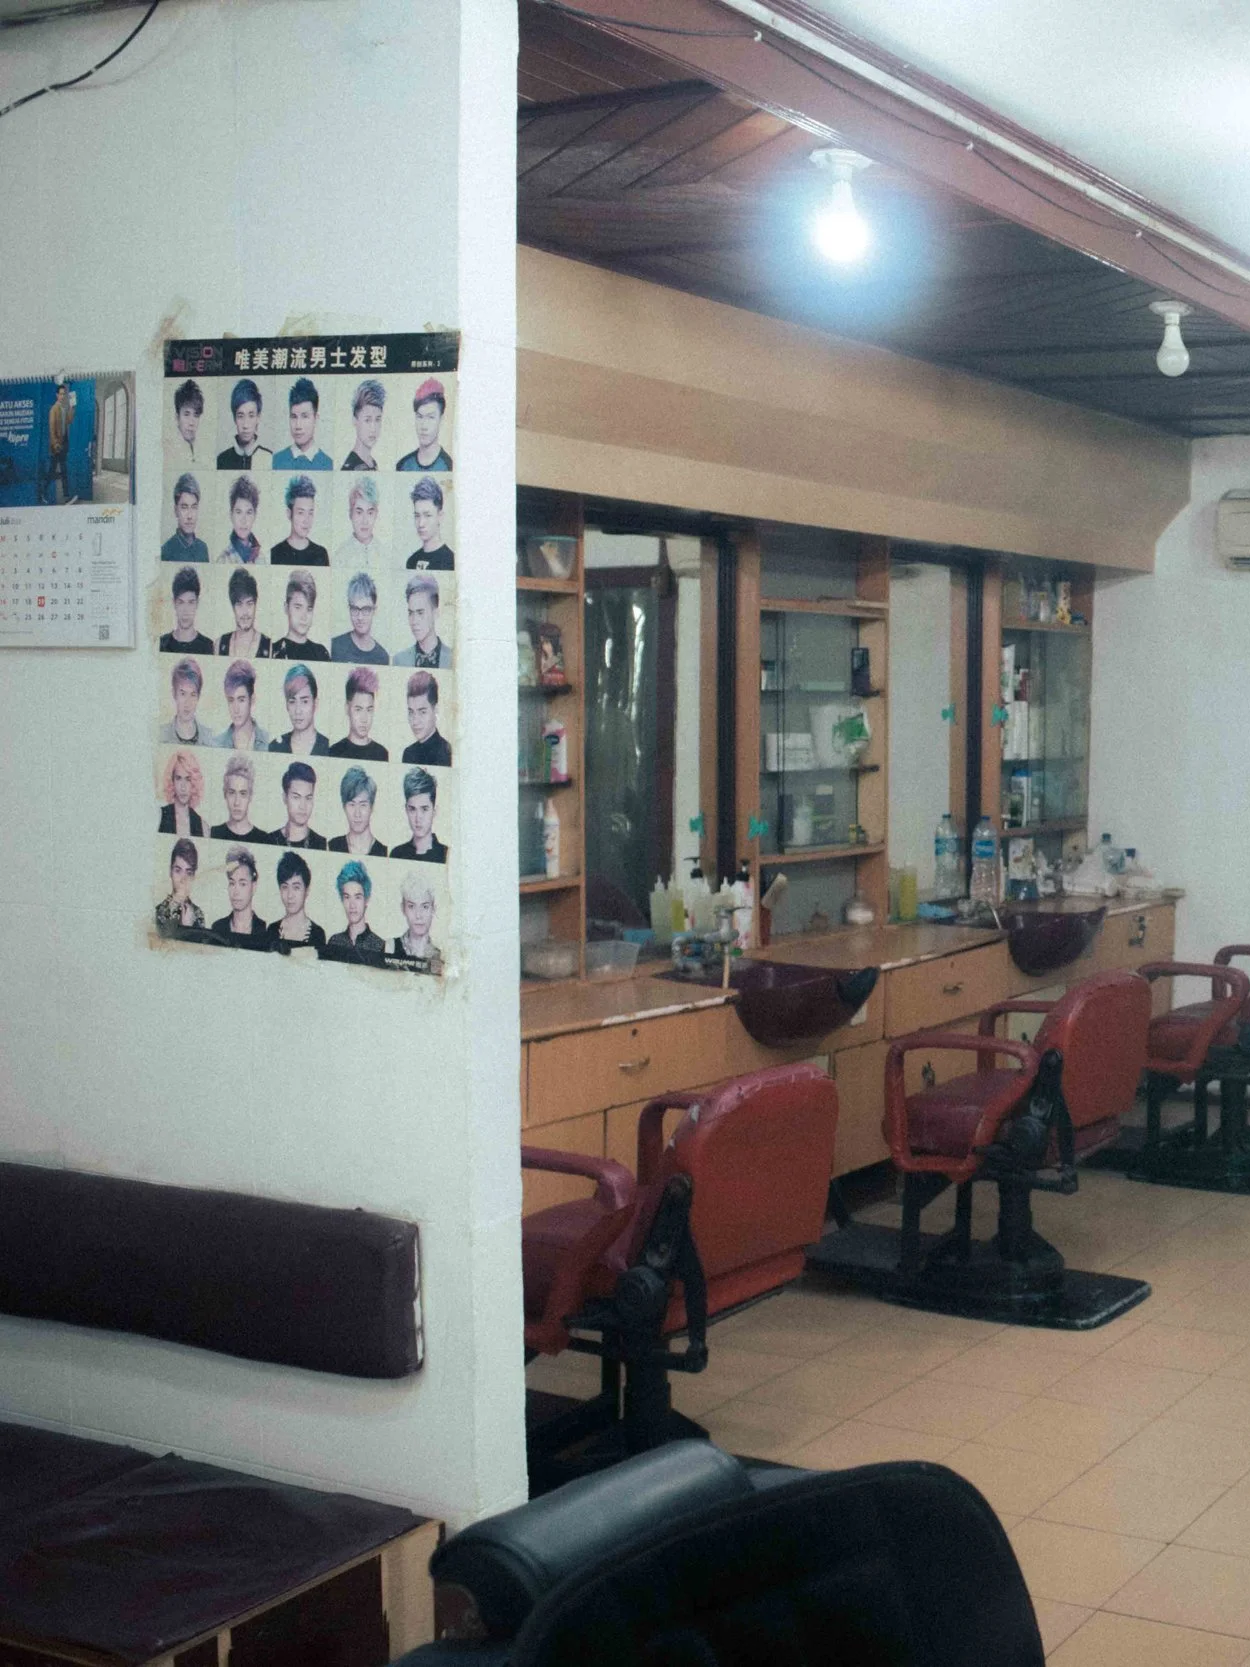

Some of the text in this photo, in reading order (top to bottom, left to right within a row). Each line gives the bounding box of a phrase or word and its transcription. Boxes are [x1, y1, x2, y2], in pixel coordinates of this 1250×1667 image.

[234, 345, 387, 370] 唯美潮流男士发型
[87, 516, 115, 524] mandiri
